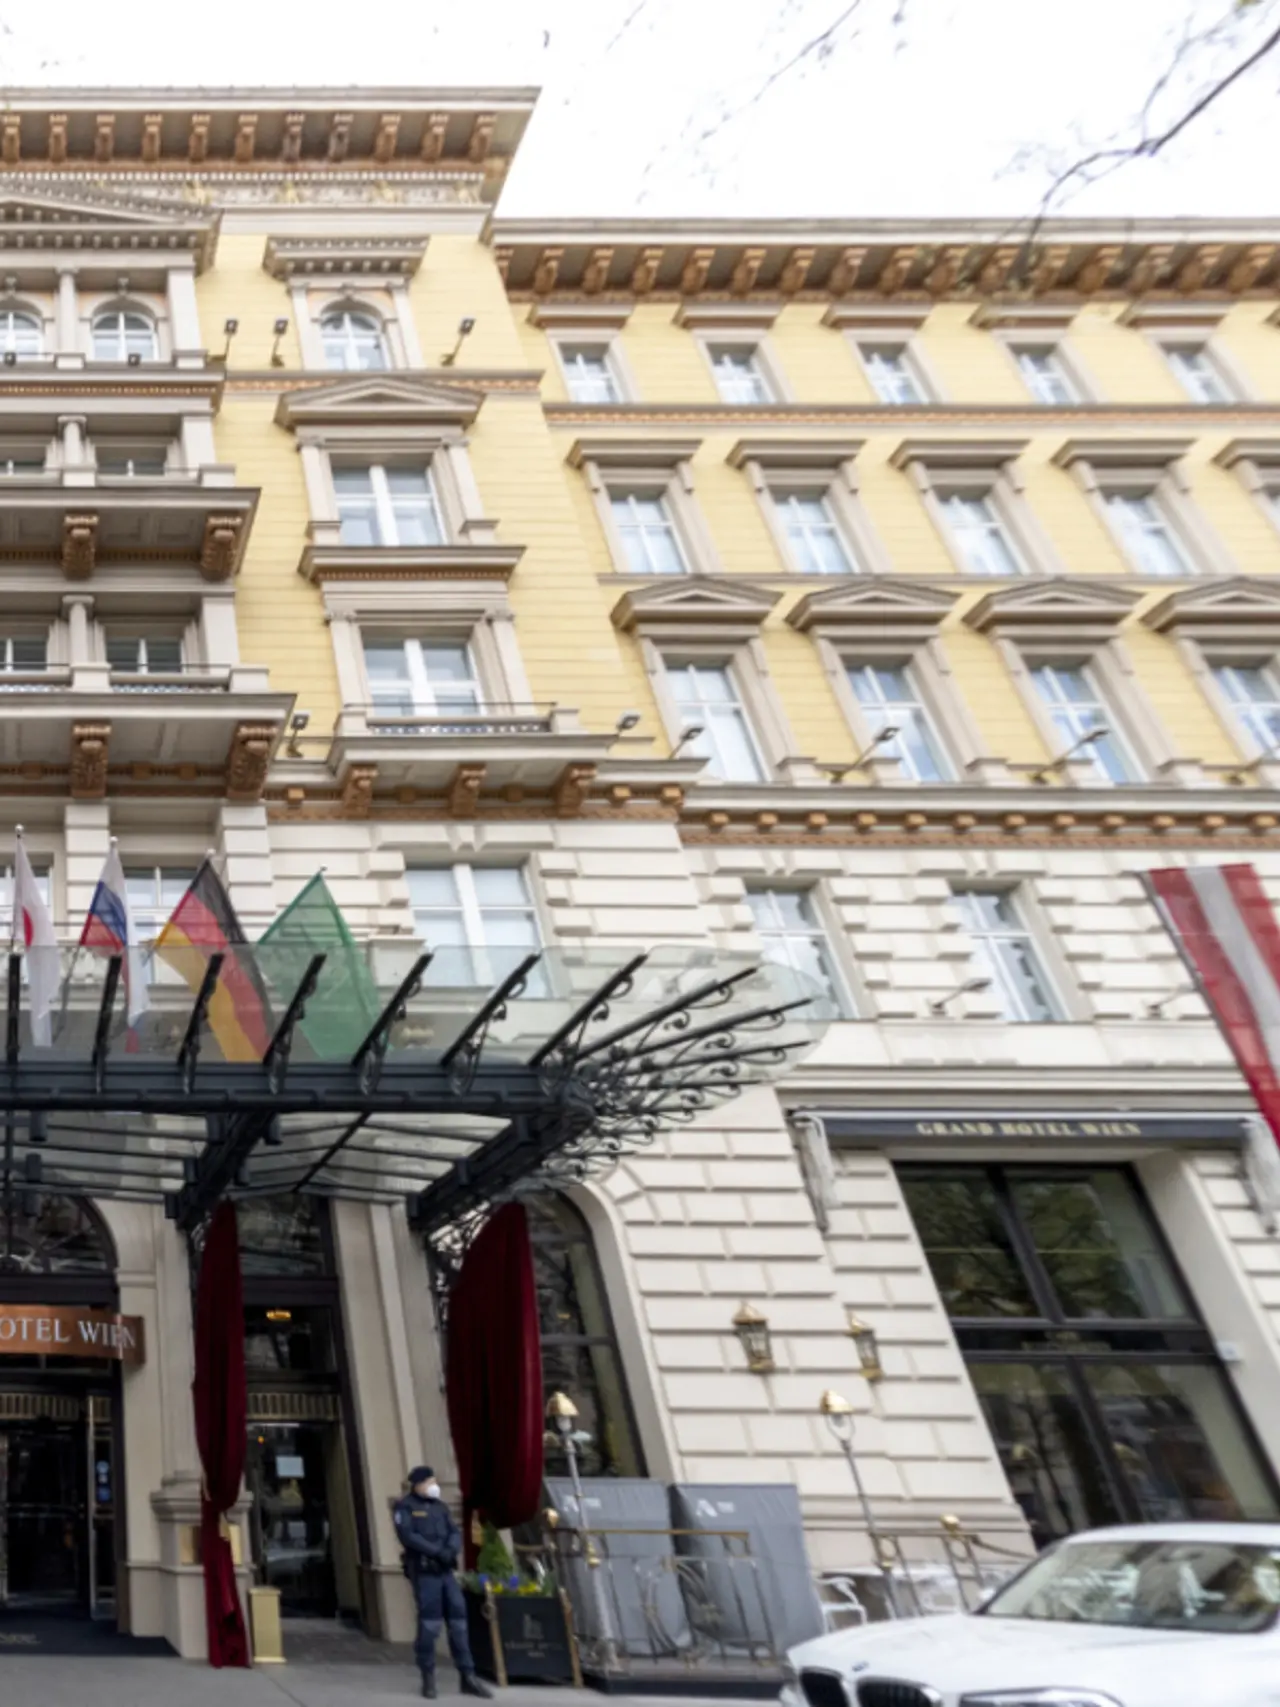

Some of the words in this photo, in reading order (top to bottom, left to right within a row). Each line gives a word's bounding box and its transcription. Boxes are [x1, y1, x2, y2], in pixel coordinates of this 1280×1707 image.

[916, 1122, 994, 1137] GRAND
[998, 1122, 1076, 1137] HOTEL
[1079, 1122, 1142, 1136] WIEN
[77, 1320, 137, 1348] WIEN
